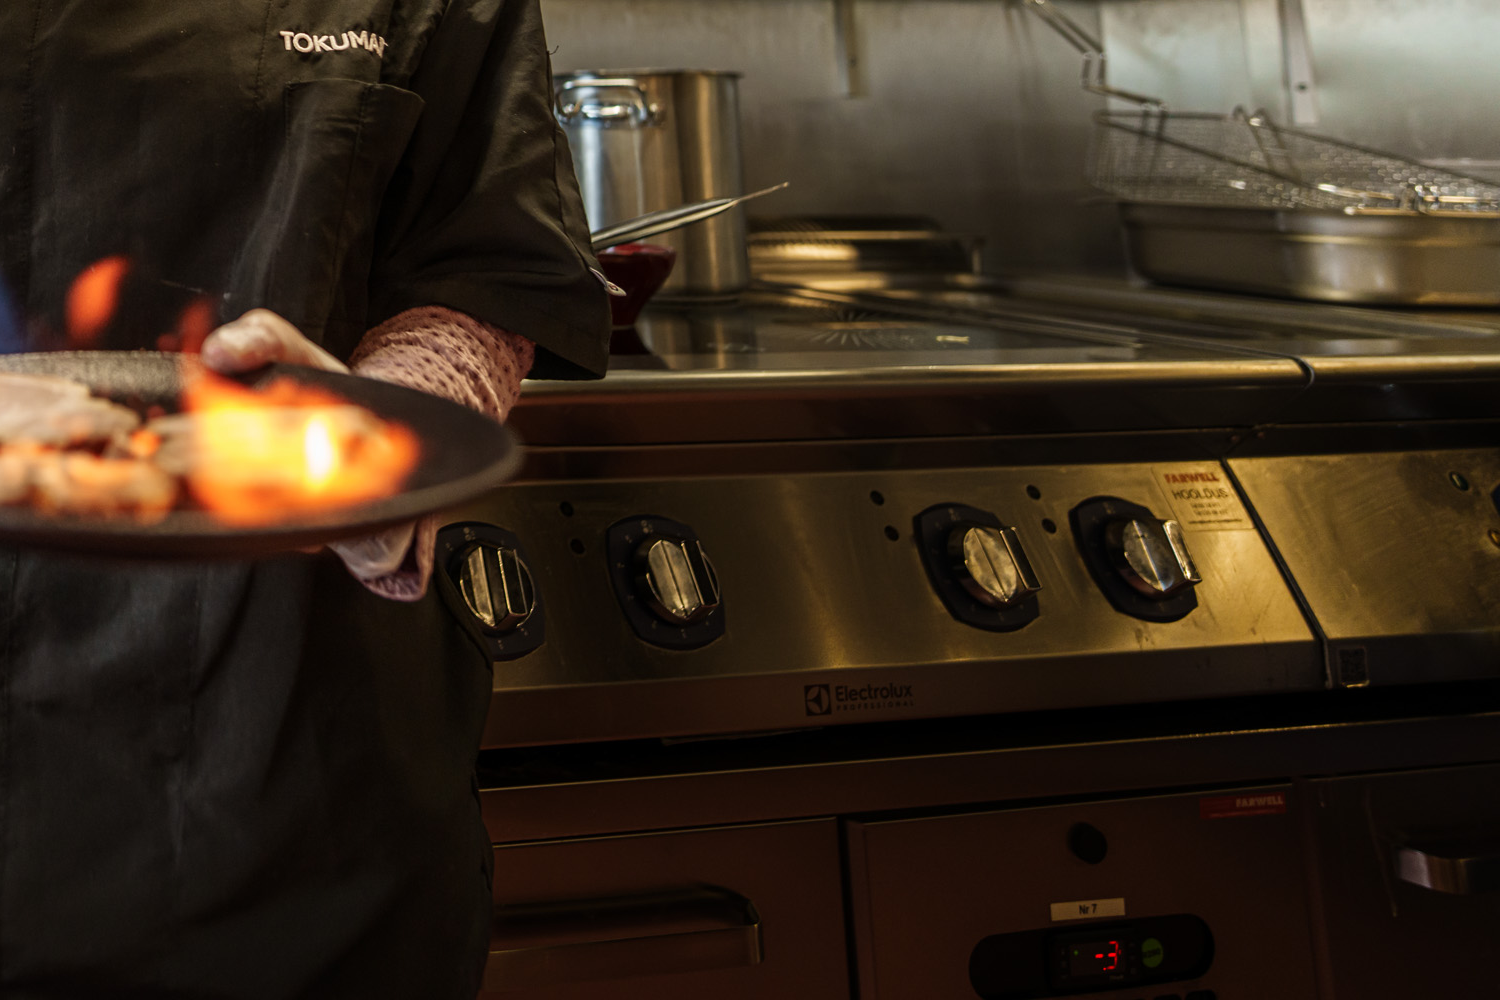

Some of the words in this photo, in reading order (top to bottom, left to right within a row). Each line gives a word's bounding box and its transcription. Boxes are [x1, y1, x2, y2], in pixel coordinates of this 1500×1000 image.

[1163, 472, 1220, 484] FARWELL
[1171, 488, 1229, 500] HOOLDUS
[835, 682, 913, 702] Electrolux
[836, 701, 914, 711] PROFESSIONAL
[1235, 795, 1283, 808] FARWELL
[1078, 904, 1089, 915] Nr
[1091, 903, 1098, 914] 7
